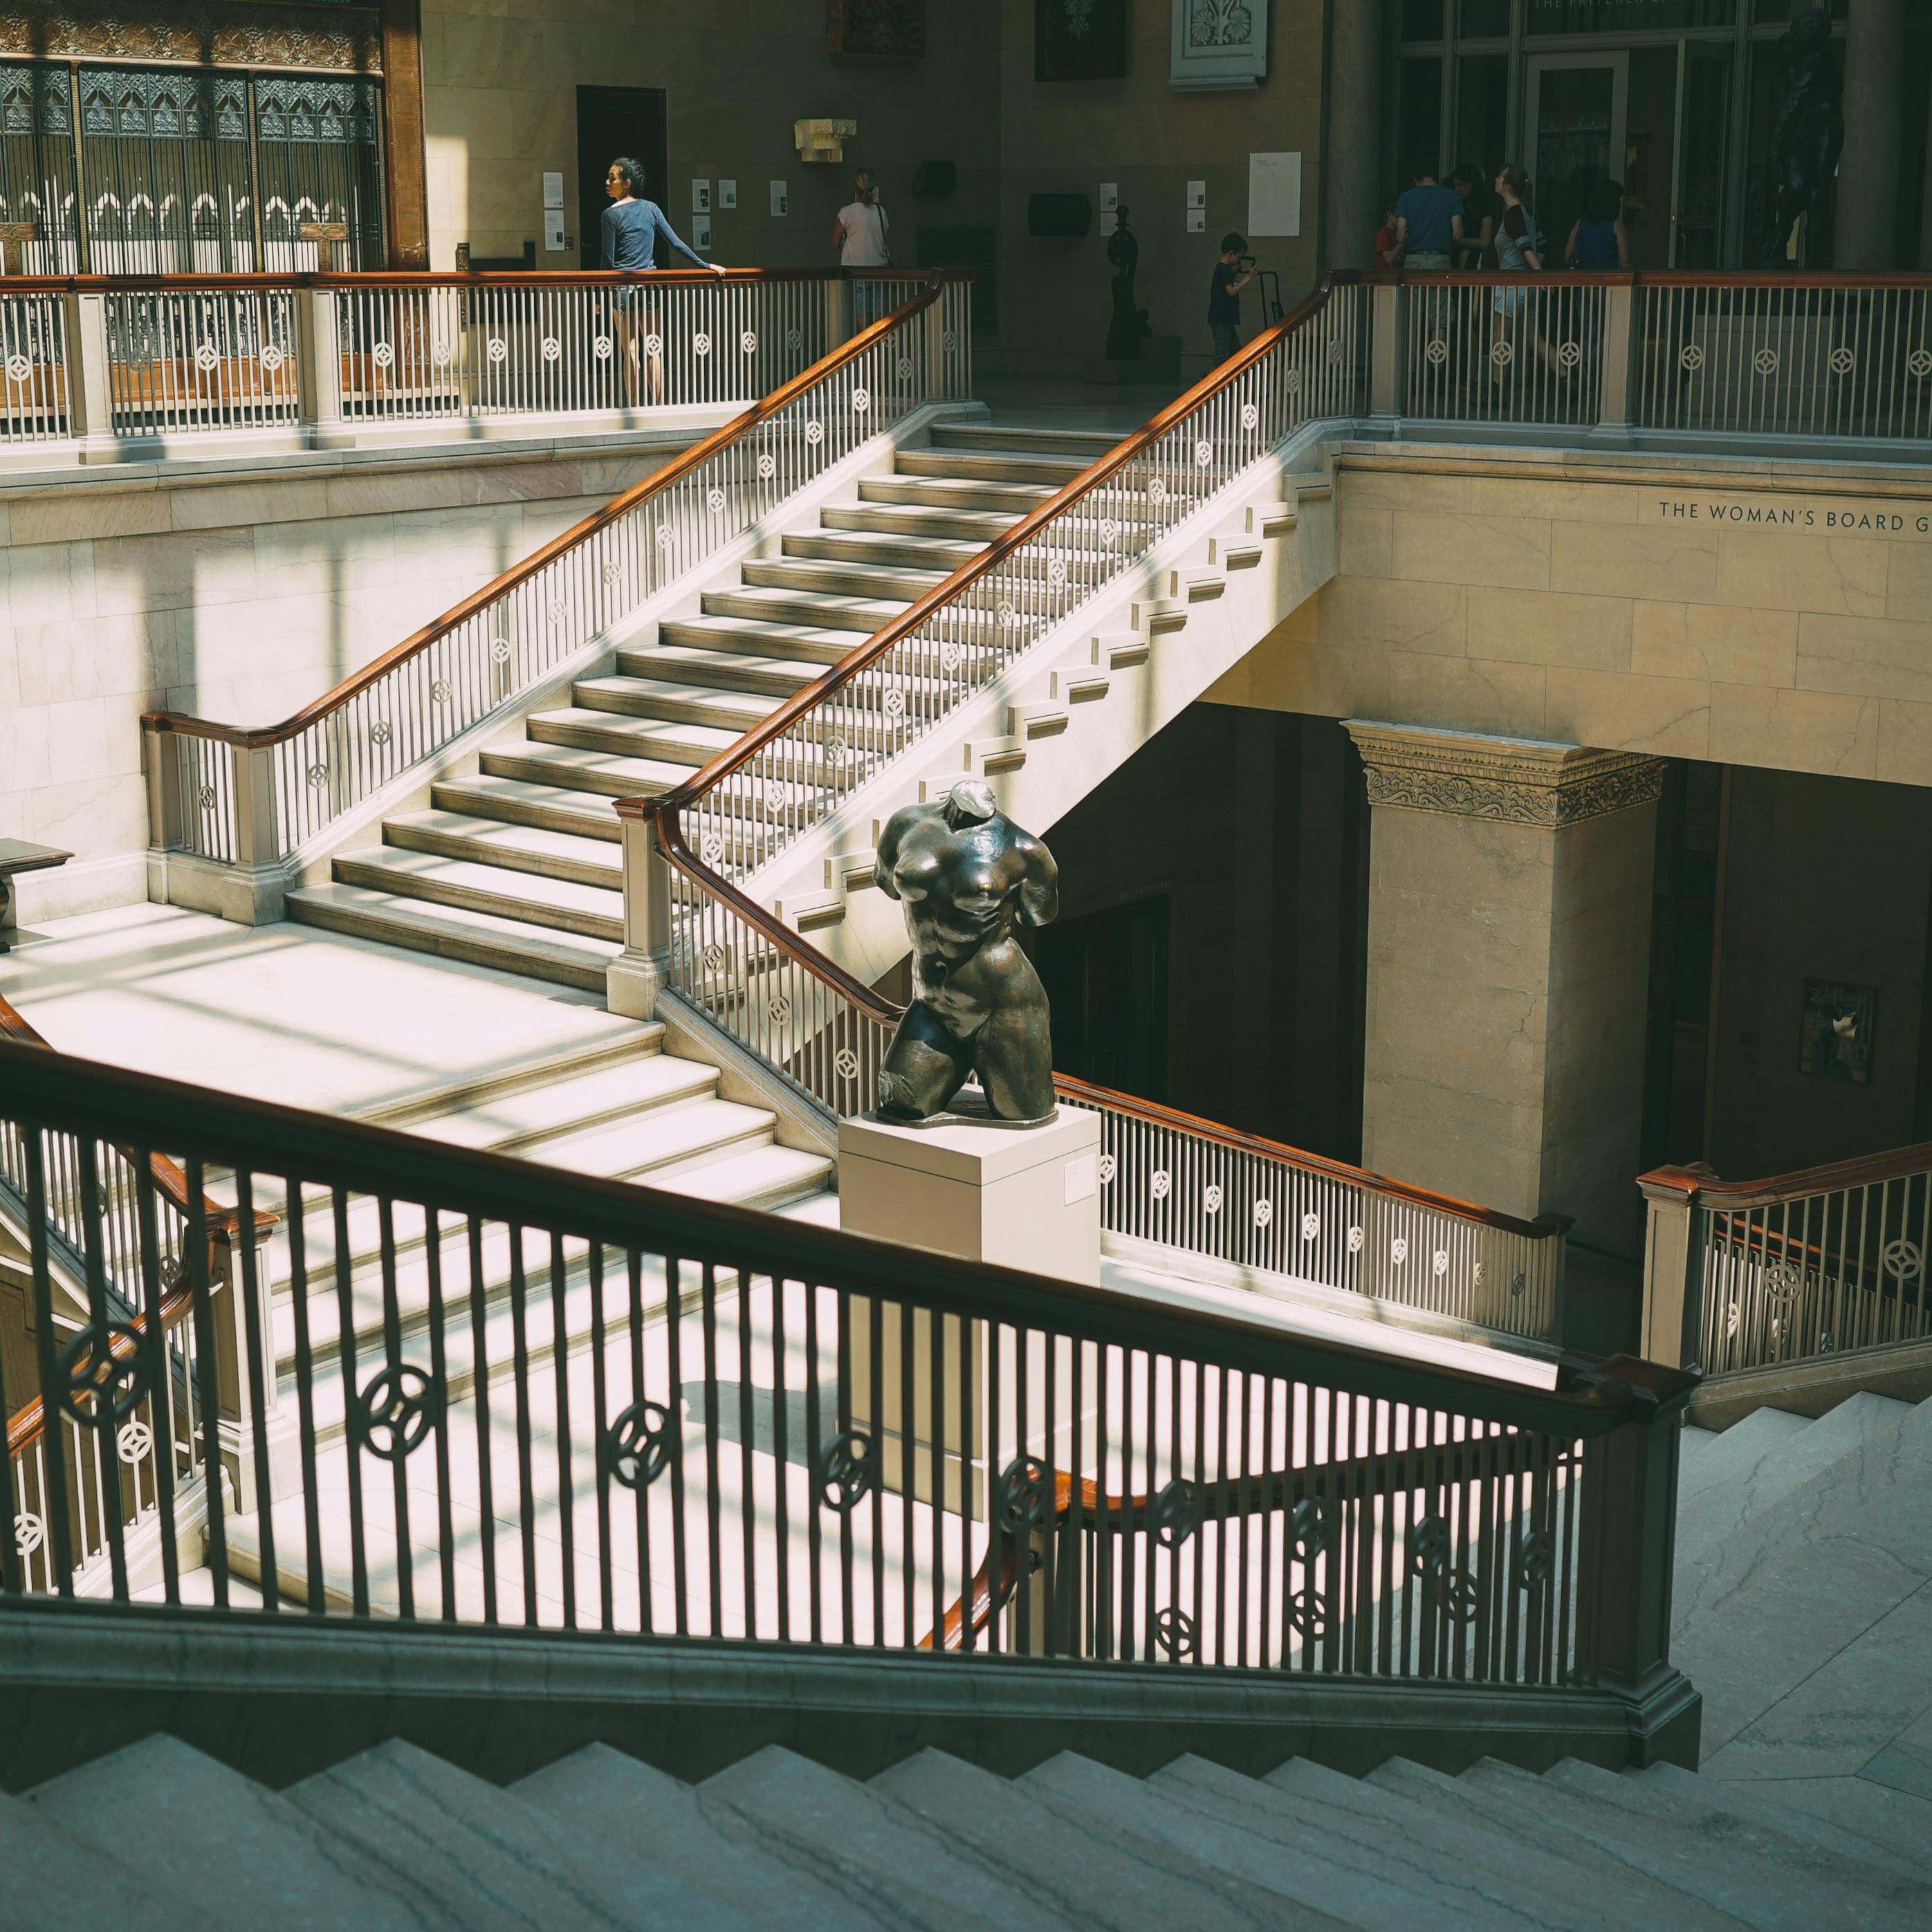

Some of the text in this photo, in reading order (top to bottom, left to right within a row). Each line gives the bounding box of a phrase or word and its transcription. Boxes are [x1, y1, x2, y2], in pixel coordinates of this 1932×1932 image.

[1659, 502, 1698, 518] THE
[1709, 505, 1814, 526] WOMAN'S
[1827, 512, 1904, 531] BOARD
[1810, 987, 1821, 1002] 2
